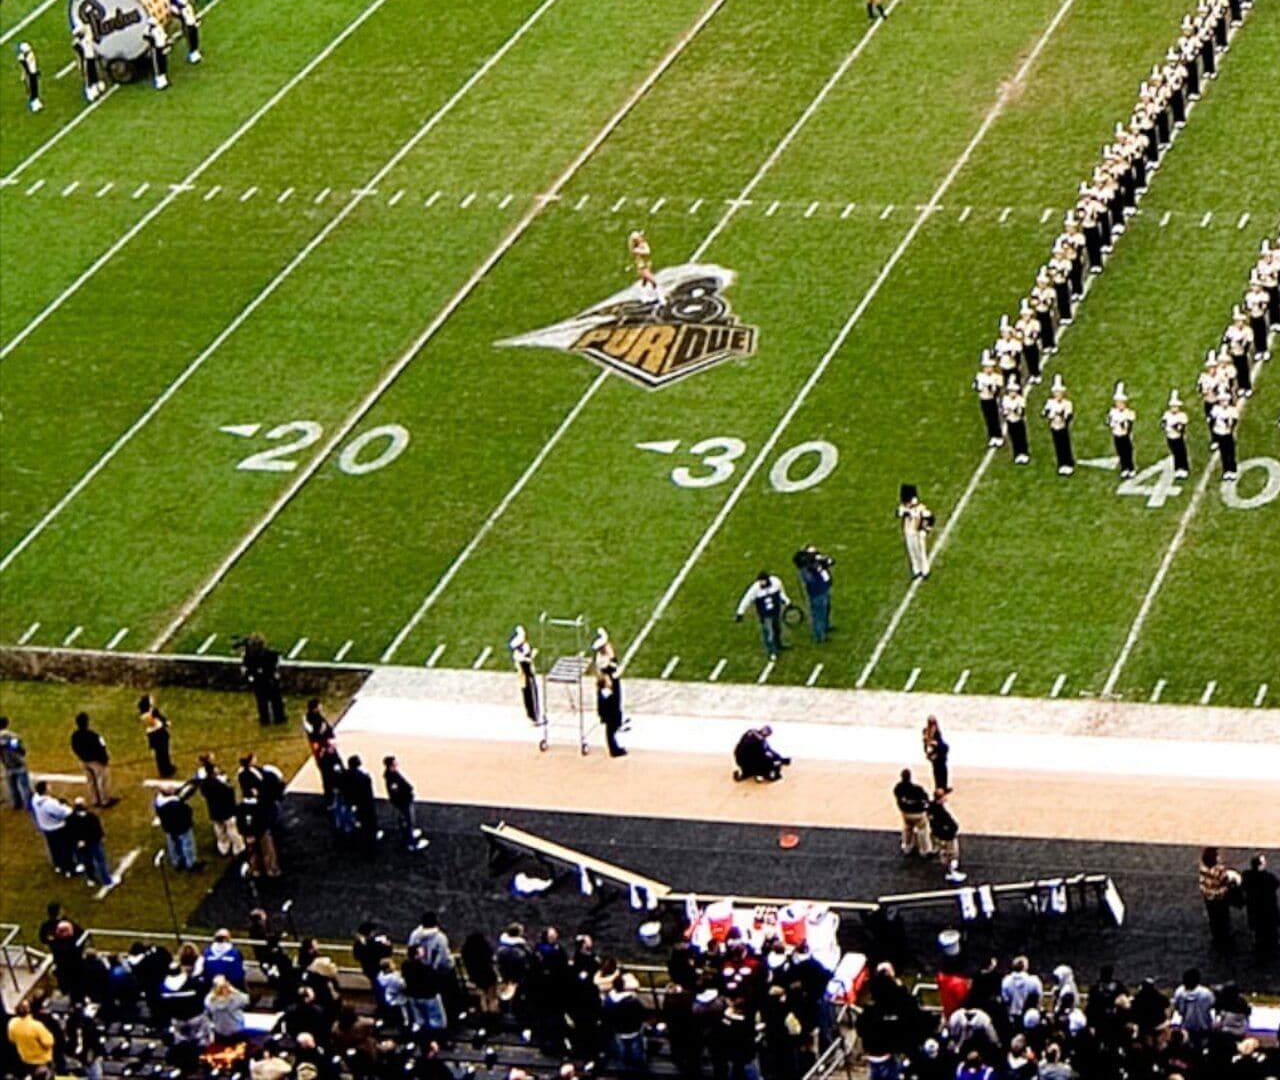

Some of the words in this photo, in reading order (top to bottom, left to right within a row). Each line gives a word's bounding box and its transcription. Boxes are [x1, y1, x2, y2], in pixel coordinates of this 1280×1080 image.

[577, 323, 750, 376] PURDUE
[236, 420, 411, 475] 20
[671, 437, 839, 493] 30
